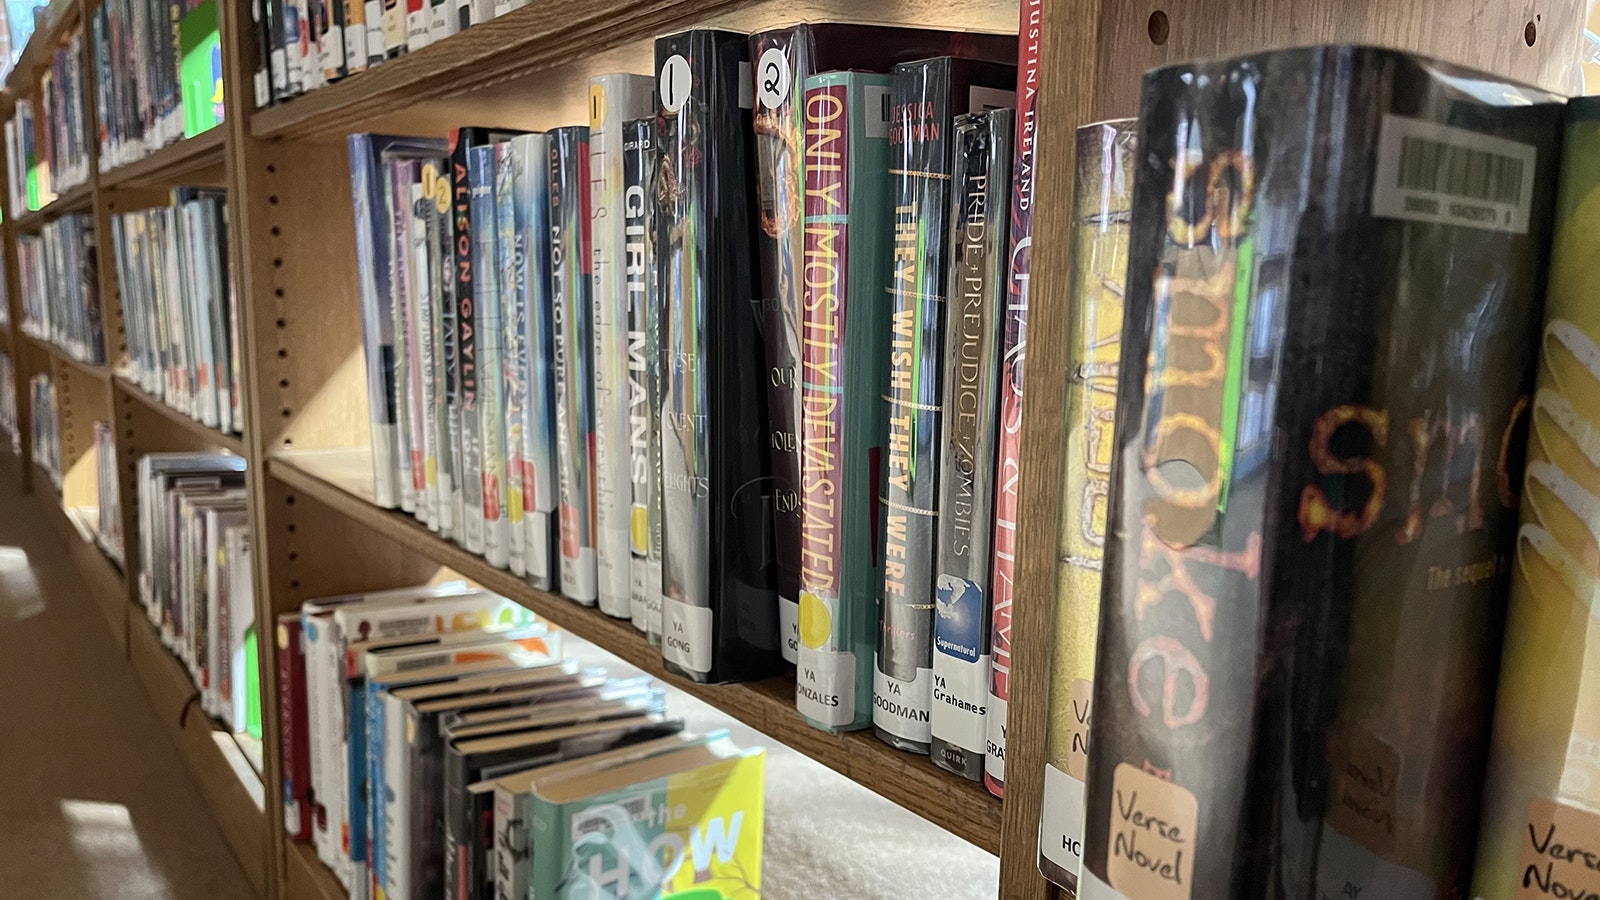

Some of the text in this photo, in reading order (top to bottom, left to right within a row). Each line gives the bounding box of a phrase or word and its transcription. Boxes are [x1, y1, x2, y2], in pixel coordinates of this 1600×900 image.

[764, 62, 780, 96] 2
[891, 101, 934, 125] JESSICA
[889, 122, 940, 147] GOOMAN
[1019, 111, 1034, 211] IRELAND
[965, 174, 987, 266] PRIDE
[593, 249, 610, 286] the
[455, 163, 475, 411] ALISON GAYLIN
[594, 301, 611, 357] edge
[625, 185, 648, 484] GIRL MANS
[801, 94, 843, 590] ONLY MOSTLY DEVASTATED
[958, 277, 983, 433] PREJUDICE
[771, 366, 799, 390] OUR
[884, 201, 918, 597] THEY WISH THEY WERE
[953, 442, 975, 557] ZOMBIES
[672, 621, 684, 633] YA
[667, 636, 690, 653] GONG
[788, 638, 798, 651] GO
[936, 636, 976, 657] Supernatural
[804, 668, 816, 682] YA
[887, 680, 901, 696] YA
[934, 674, 946, 689] YA
[798, 683, 839, 707] ONZALES
[933, 688, 986, 716] Grahames
[940, 749, 967, 767] QUIRK
[986, 740, 1005, 761] GRA
[1117, 790, 1184, 843] Verse
[1113, 831, 1183, 885] Novel
[1529, 823, 1600, 872] Vers
